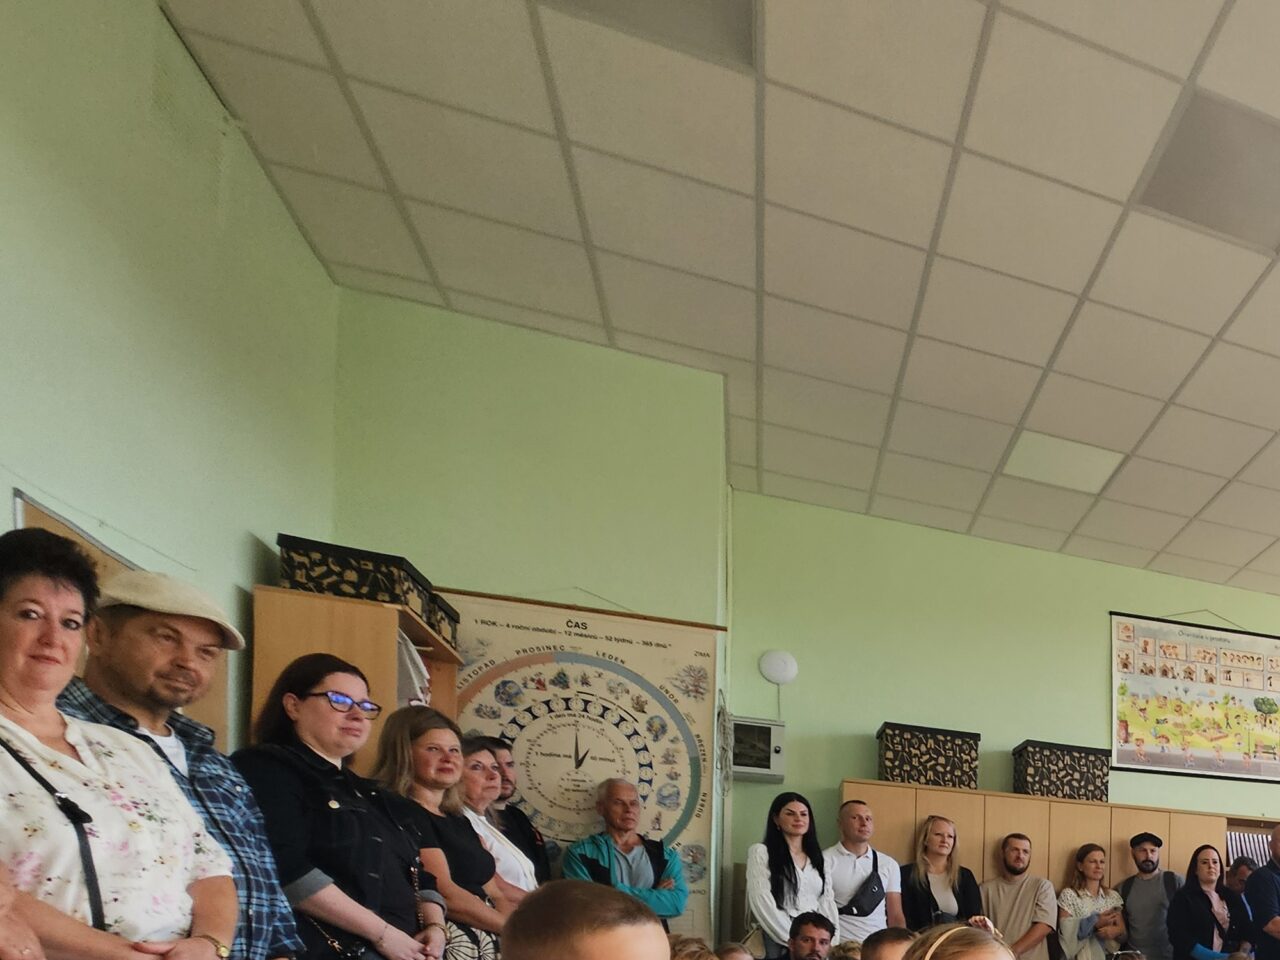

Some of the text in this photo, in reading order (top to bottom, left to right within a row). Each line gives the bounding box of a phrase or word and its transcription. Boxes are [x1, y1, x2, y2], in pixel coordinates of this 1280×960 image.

[566, 619, 588, 630] ČAS
[515, 645, 565, 655] PROSINEC
[596, 651, 626, 665] LEDEN
[457, 659, 496, 690] LISTOPAD
[695, 792, 708, 818] DUBEN
